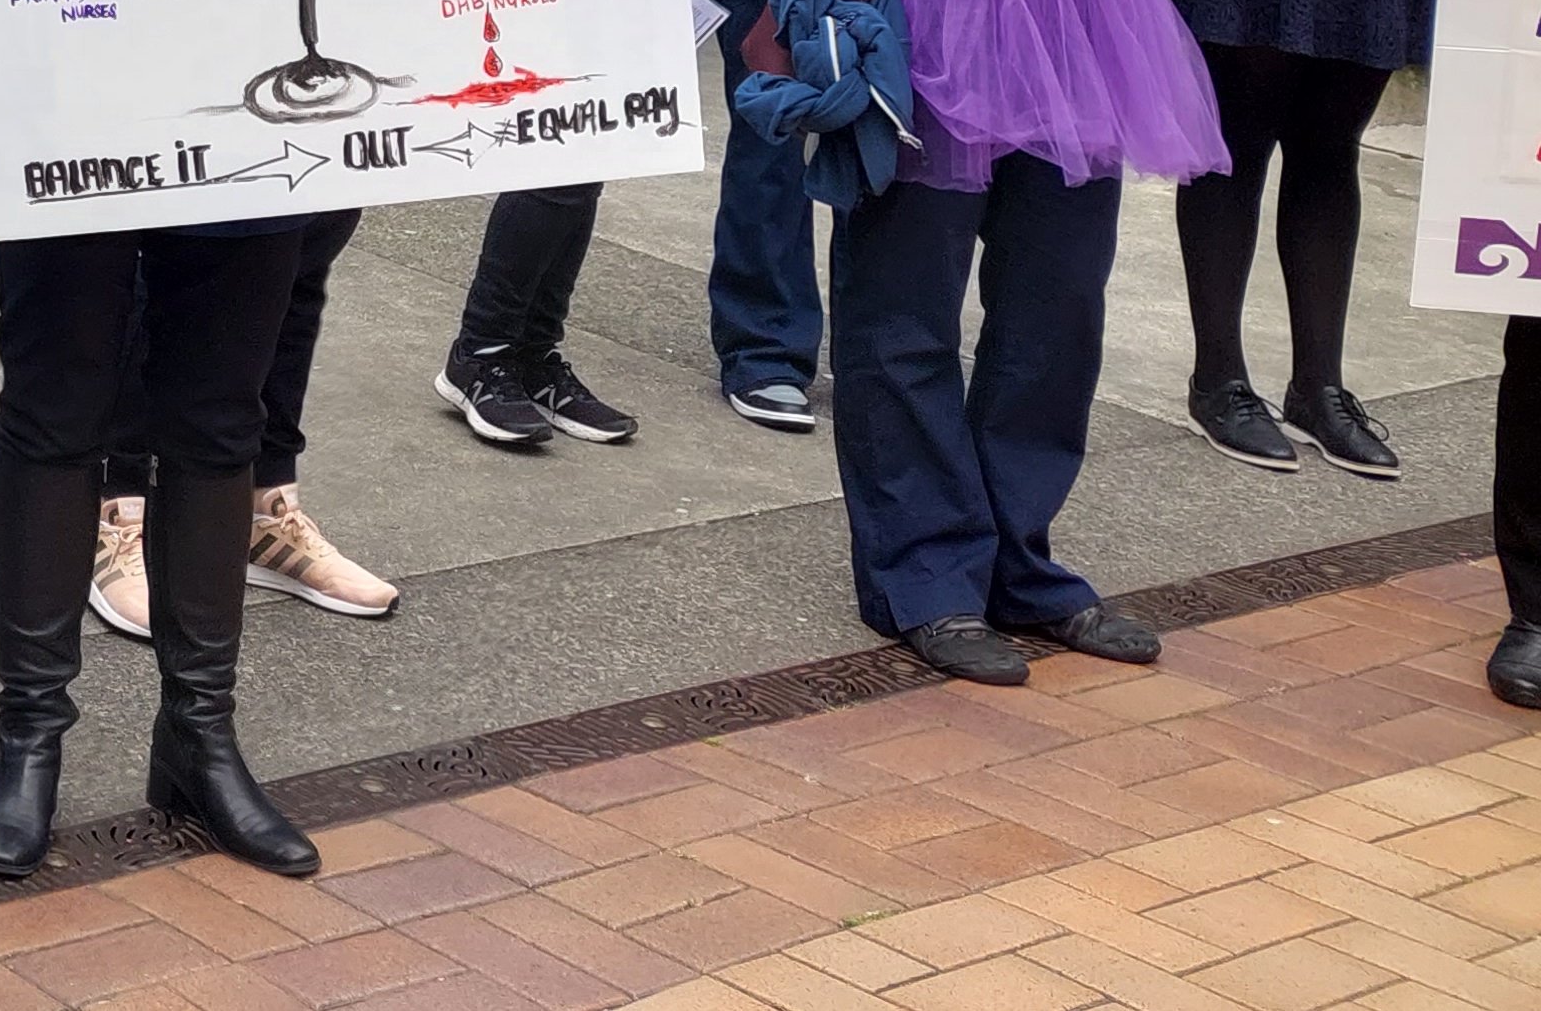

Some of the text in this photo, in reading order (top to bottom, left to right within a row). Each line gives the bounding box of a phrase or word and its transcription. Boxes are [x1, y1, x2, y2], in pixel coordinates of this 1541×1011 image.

[61, 3, 118, 23] NURSES
[342, 125, 415, 171] OUT
[624, 86, 682, 138] PAY
